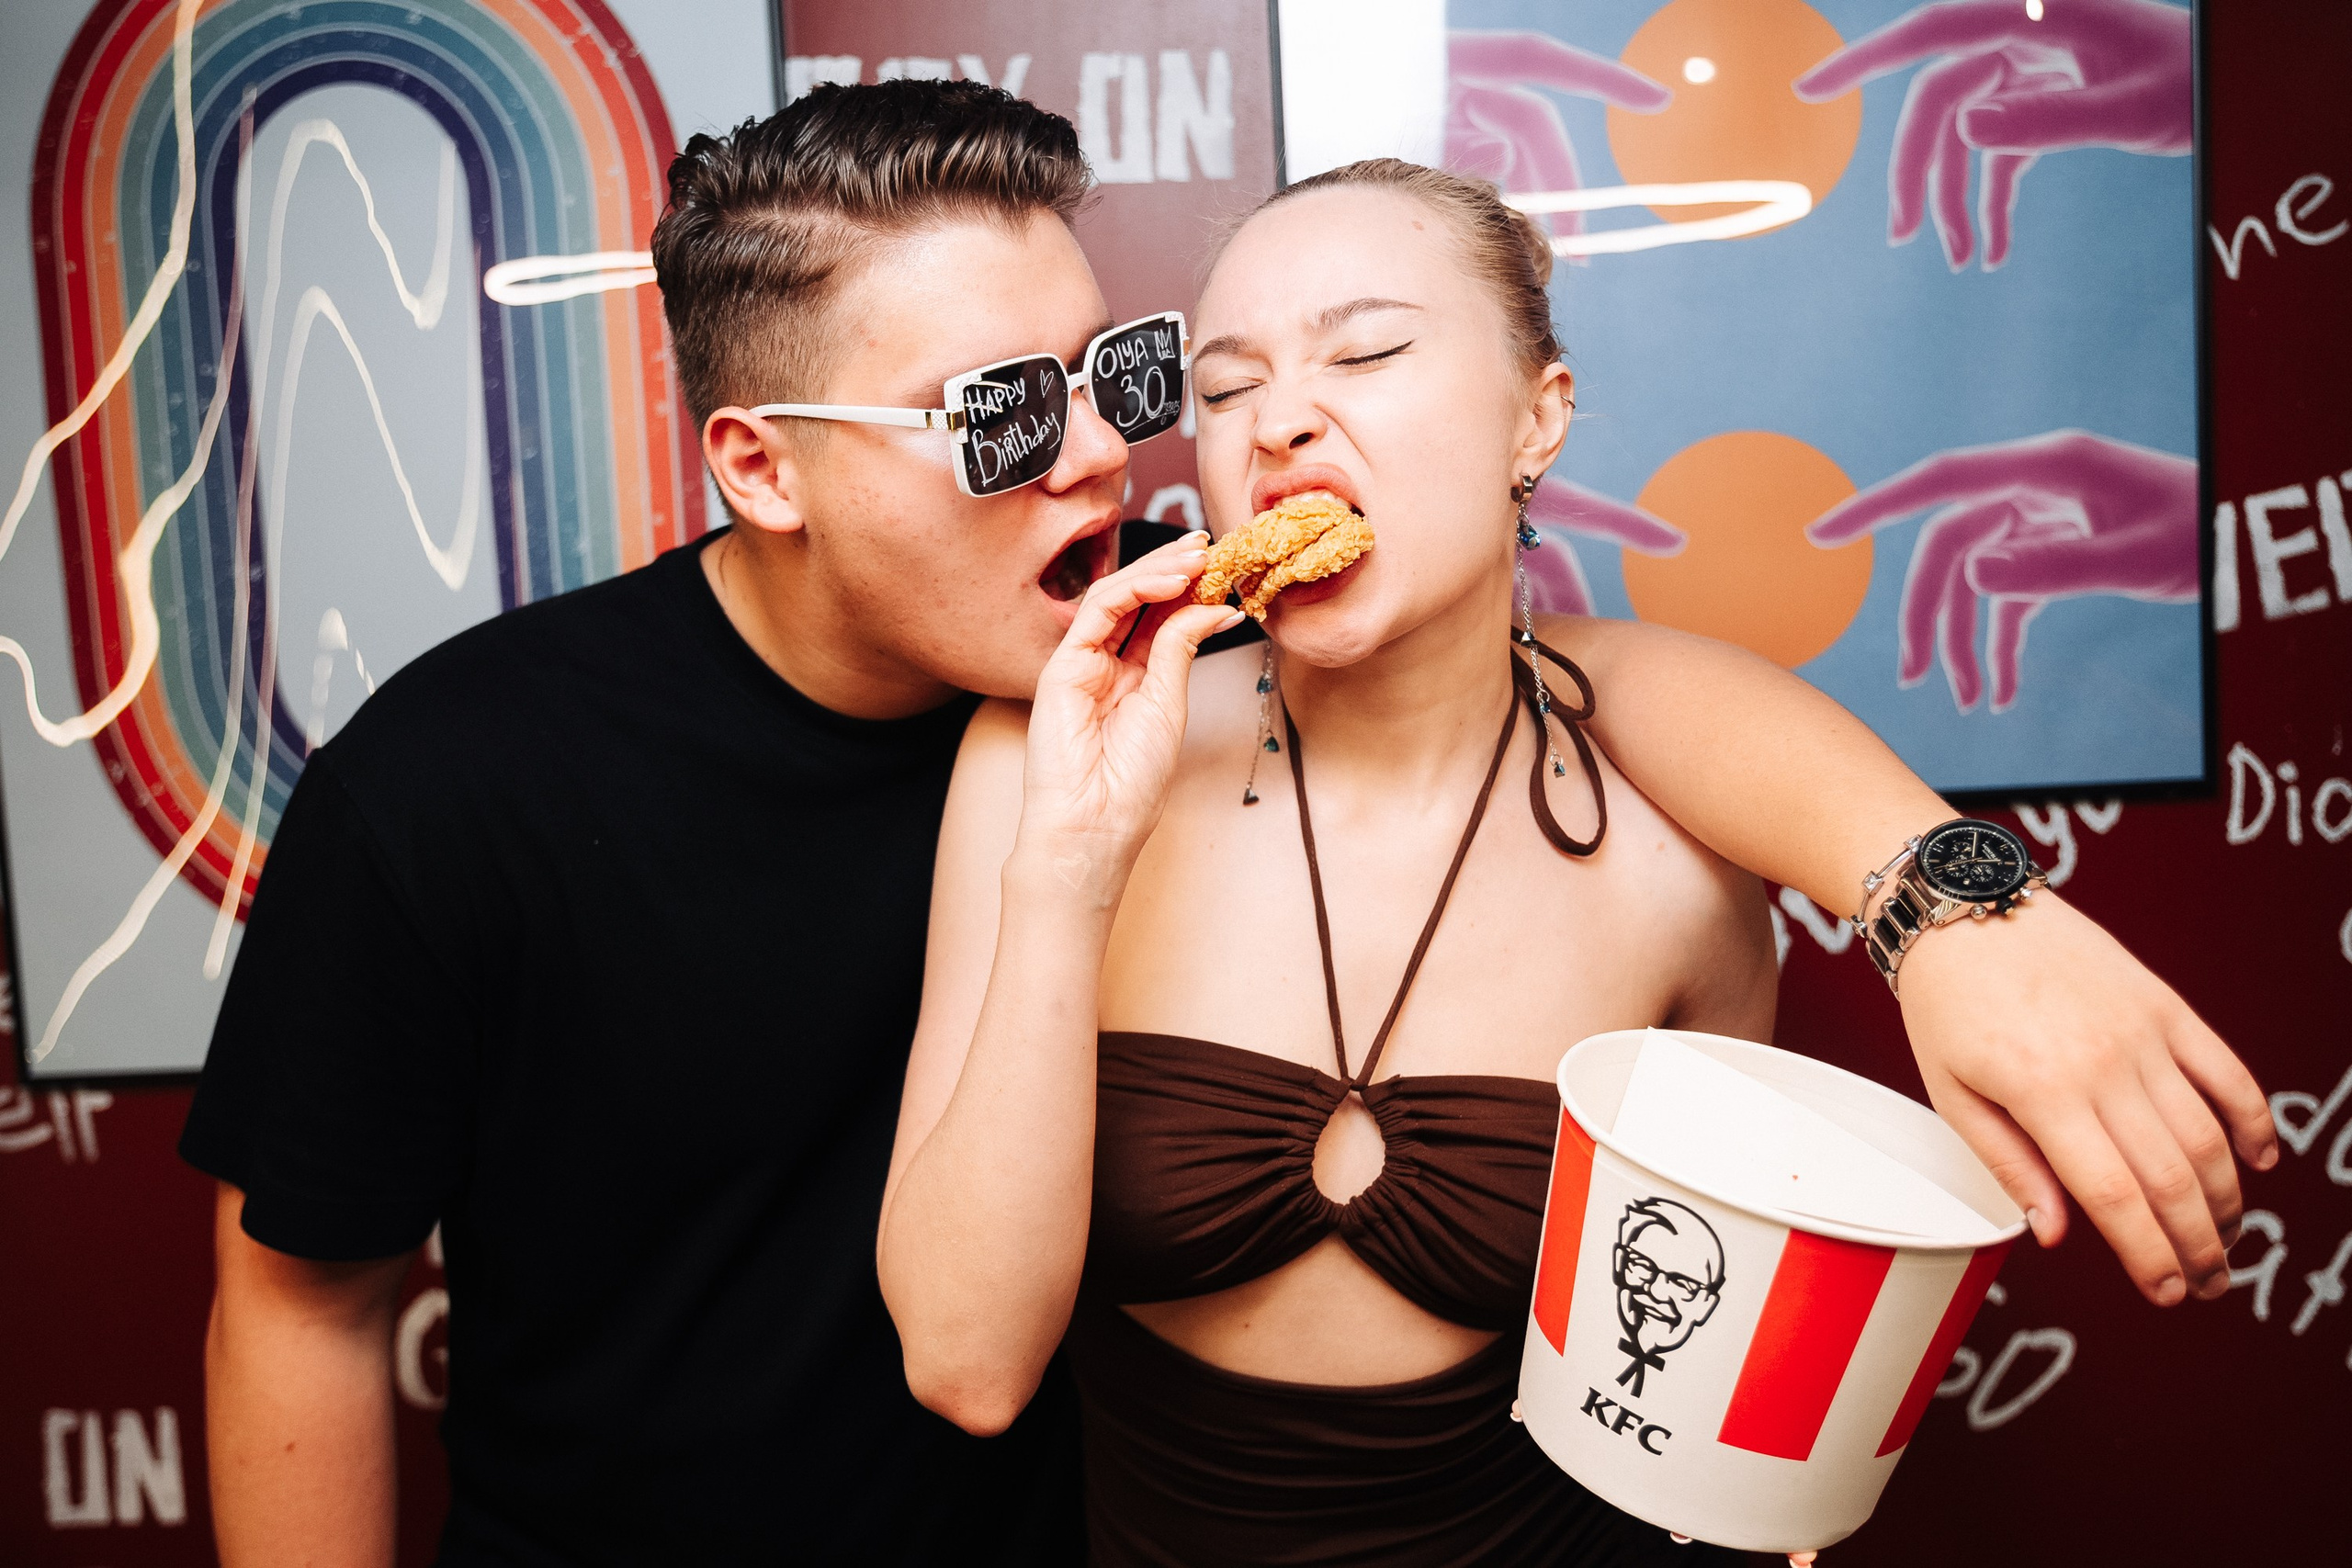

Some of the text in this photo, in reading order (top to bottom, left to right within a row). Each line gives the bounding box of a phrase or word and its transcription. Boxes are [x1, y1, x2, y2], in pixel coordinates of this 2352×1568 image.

[1079, 50, 1234, 184] ON
[966, 378, 1026, 423] HAPPY
[1116, 366, 1166, 427] 30
[1579, 1386, 1672, 1456] KFC
[42, 1406, 186, 1527] ON
